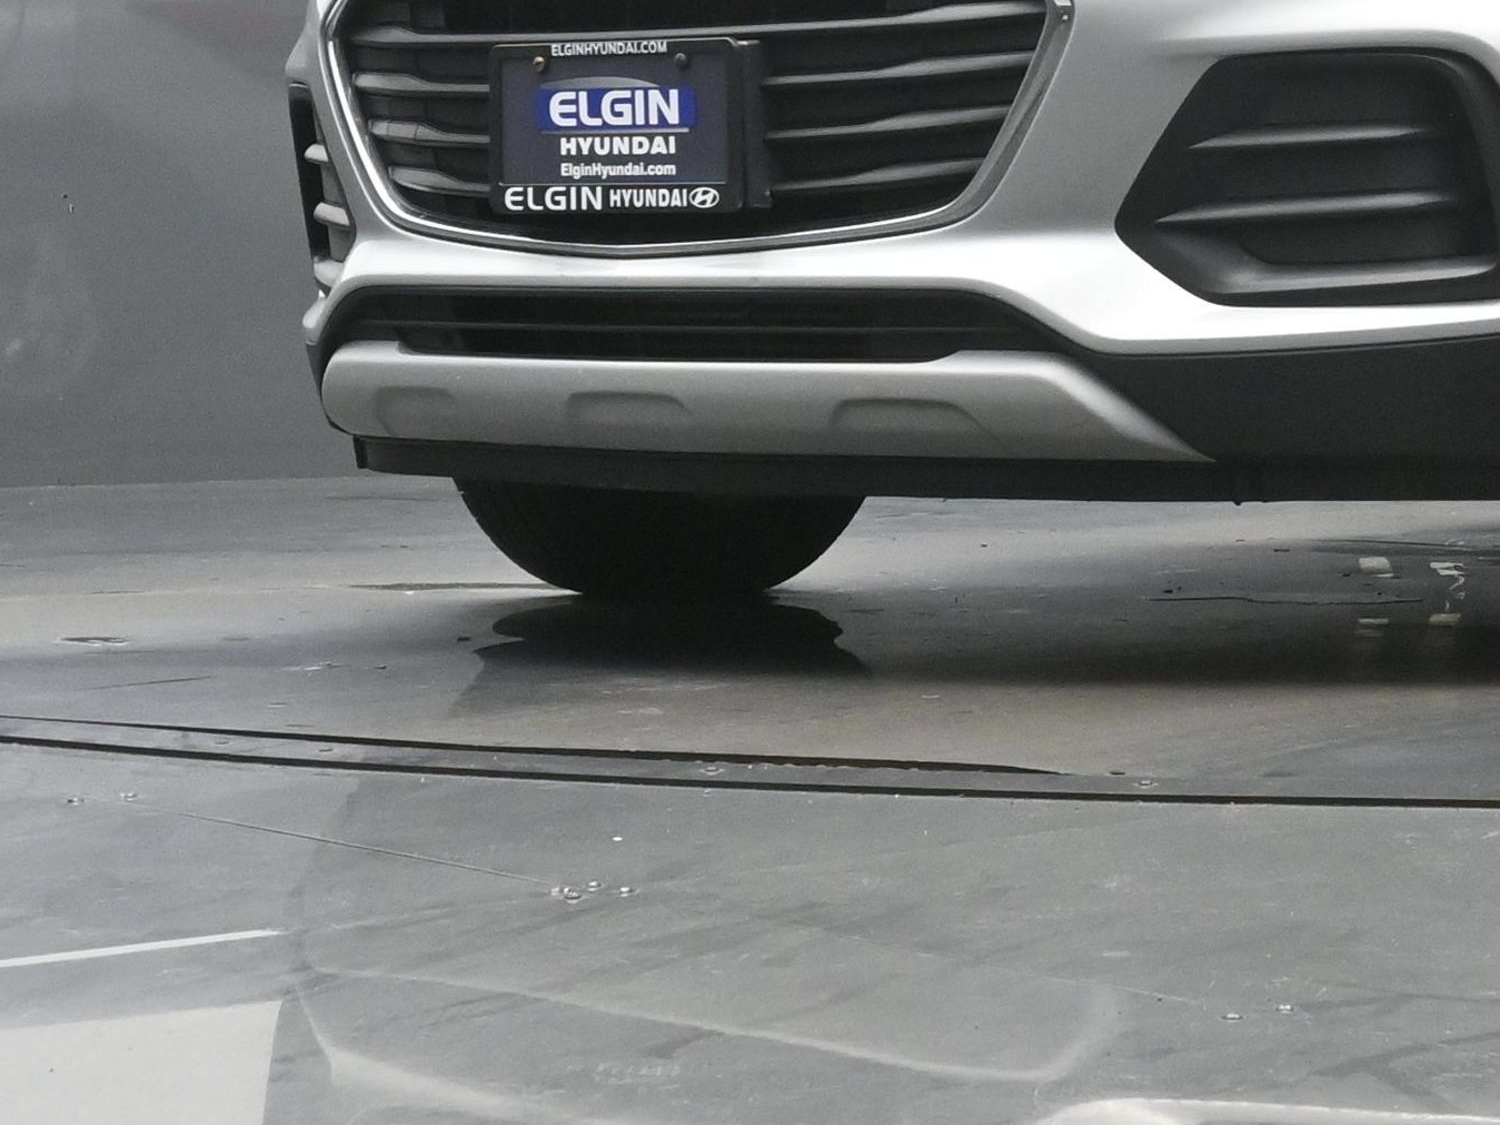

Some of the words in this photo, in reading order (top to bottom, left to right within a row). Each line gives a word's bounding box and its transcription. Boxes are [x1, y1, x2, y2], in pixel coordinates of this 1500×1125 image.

[551, 41, 668, 57] ELGINHYUNDAI.COM
[549, 89, 680, 127] ELGIN
[560, 136, 677, 156] HYUNDAI
[560, 162, 677, 180] ElginHyundai.com
[504, 186, 602, 211] ELGIN
[609, 188, 688, 208] HYUNDAI
